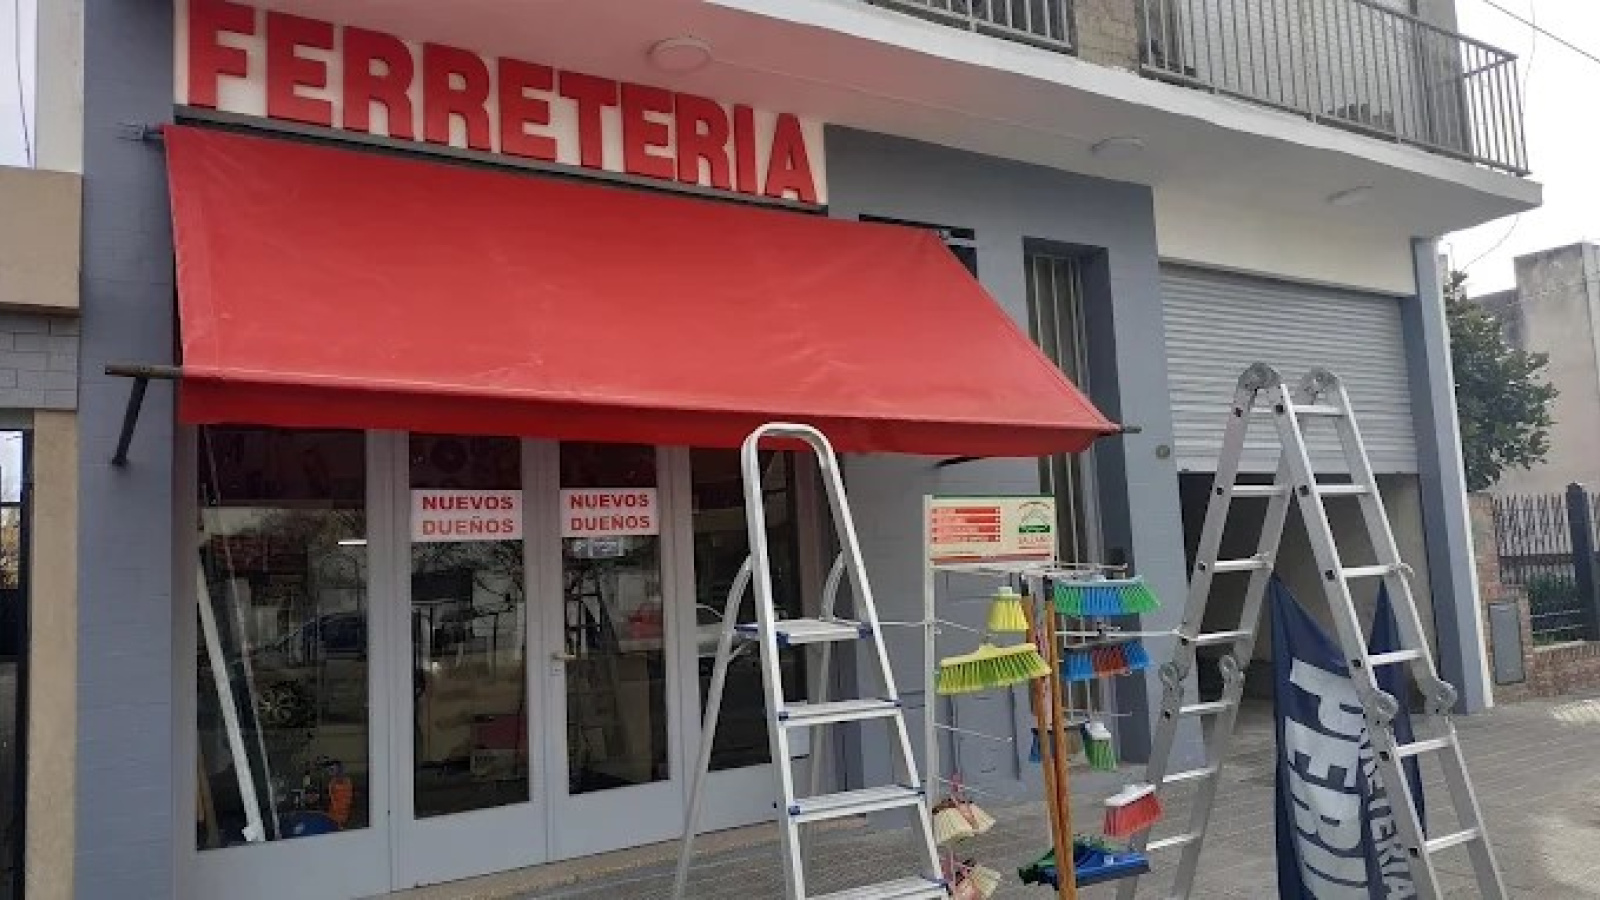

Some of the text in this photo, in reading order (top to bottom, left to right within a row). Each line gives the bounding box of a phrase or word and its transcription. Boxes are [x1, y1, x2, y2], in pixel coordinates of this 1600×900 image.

[187, 0, 817, 204] FERRETERIA
[422, 496, 514, 510] NUEVOS
[570, 494, 650, 509] NUEVOS
[422, 516, 514, 535] DUEÑOS
[570, 514, 650, 531] DUEÑOS
